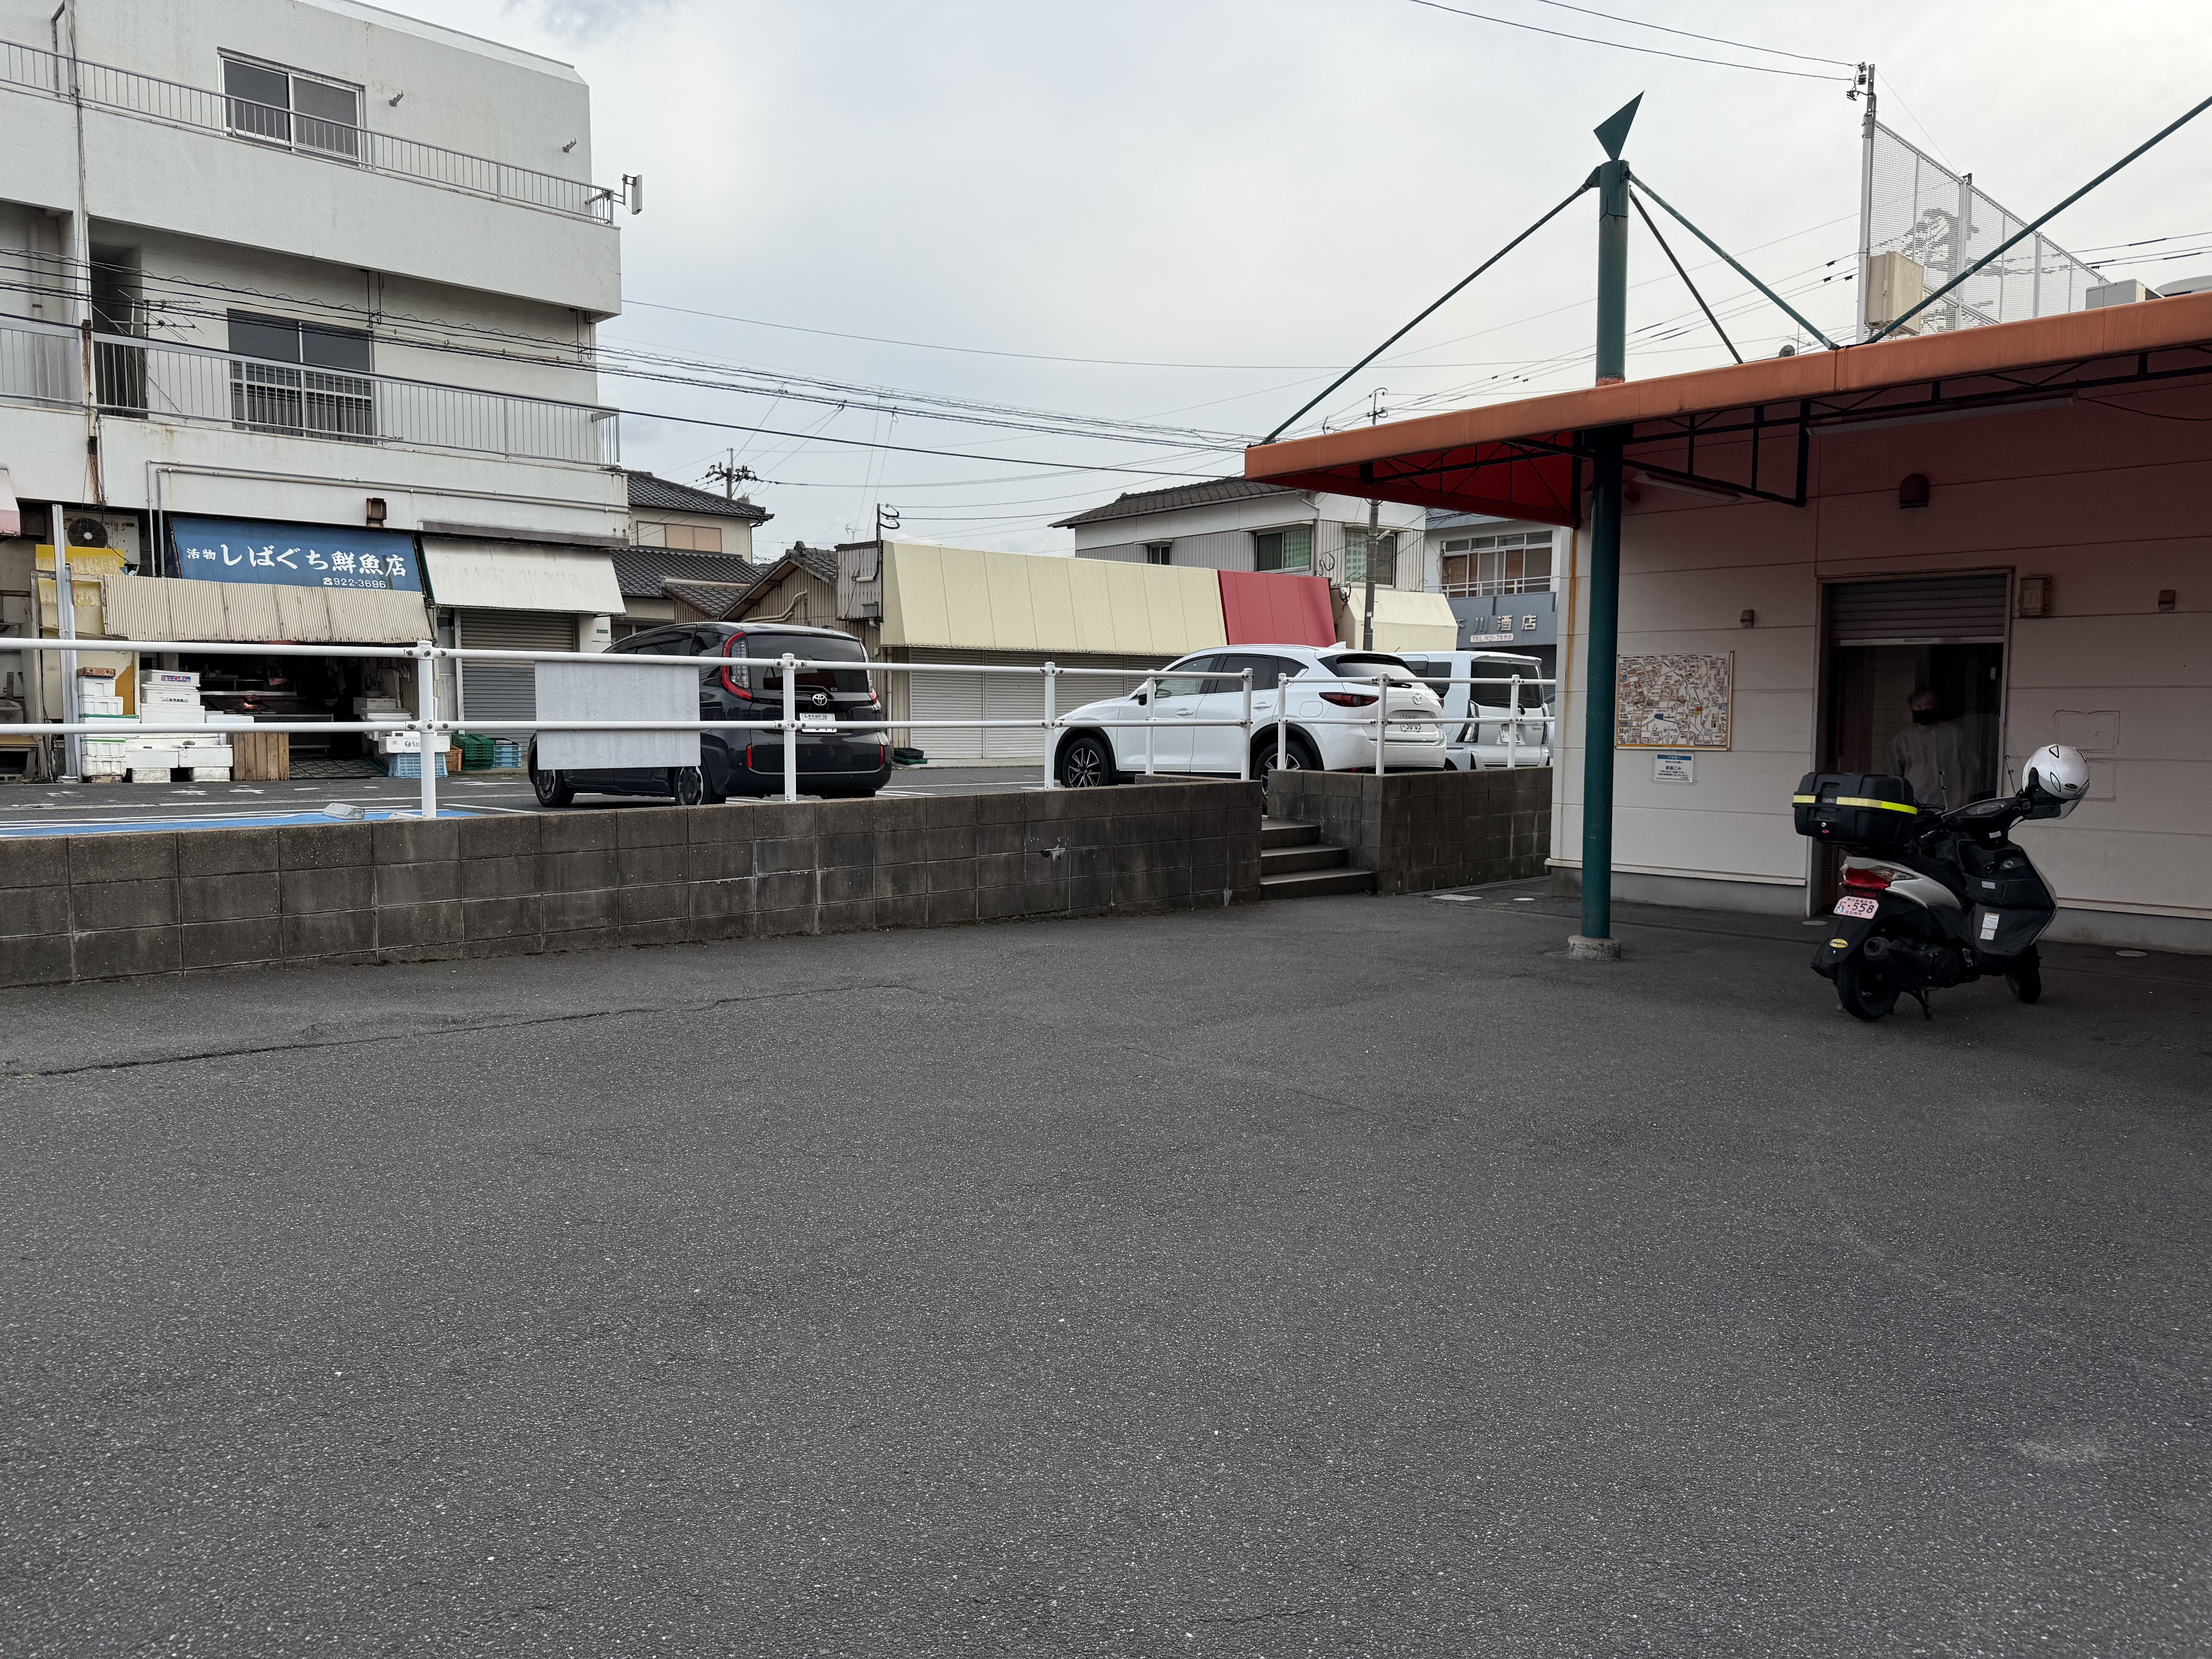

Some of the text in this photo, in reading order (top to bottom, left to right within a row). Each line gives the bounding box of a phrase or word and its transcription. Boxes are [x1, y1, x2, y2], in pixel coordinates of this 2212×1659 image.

[187, 544, 406, 577] 活物 しばぐち鮮魚店
[1456, 615, 1537, 634] 下川酒店
